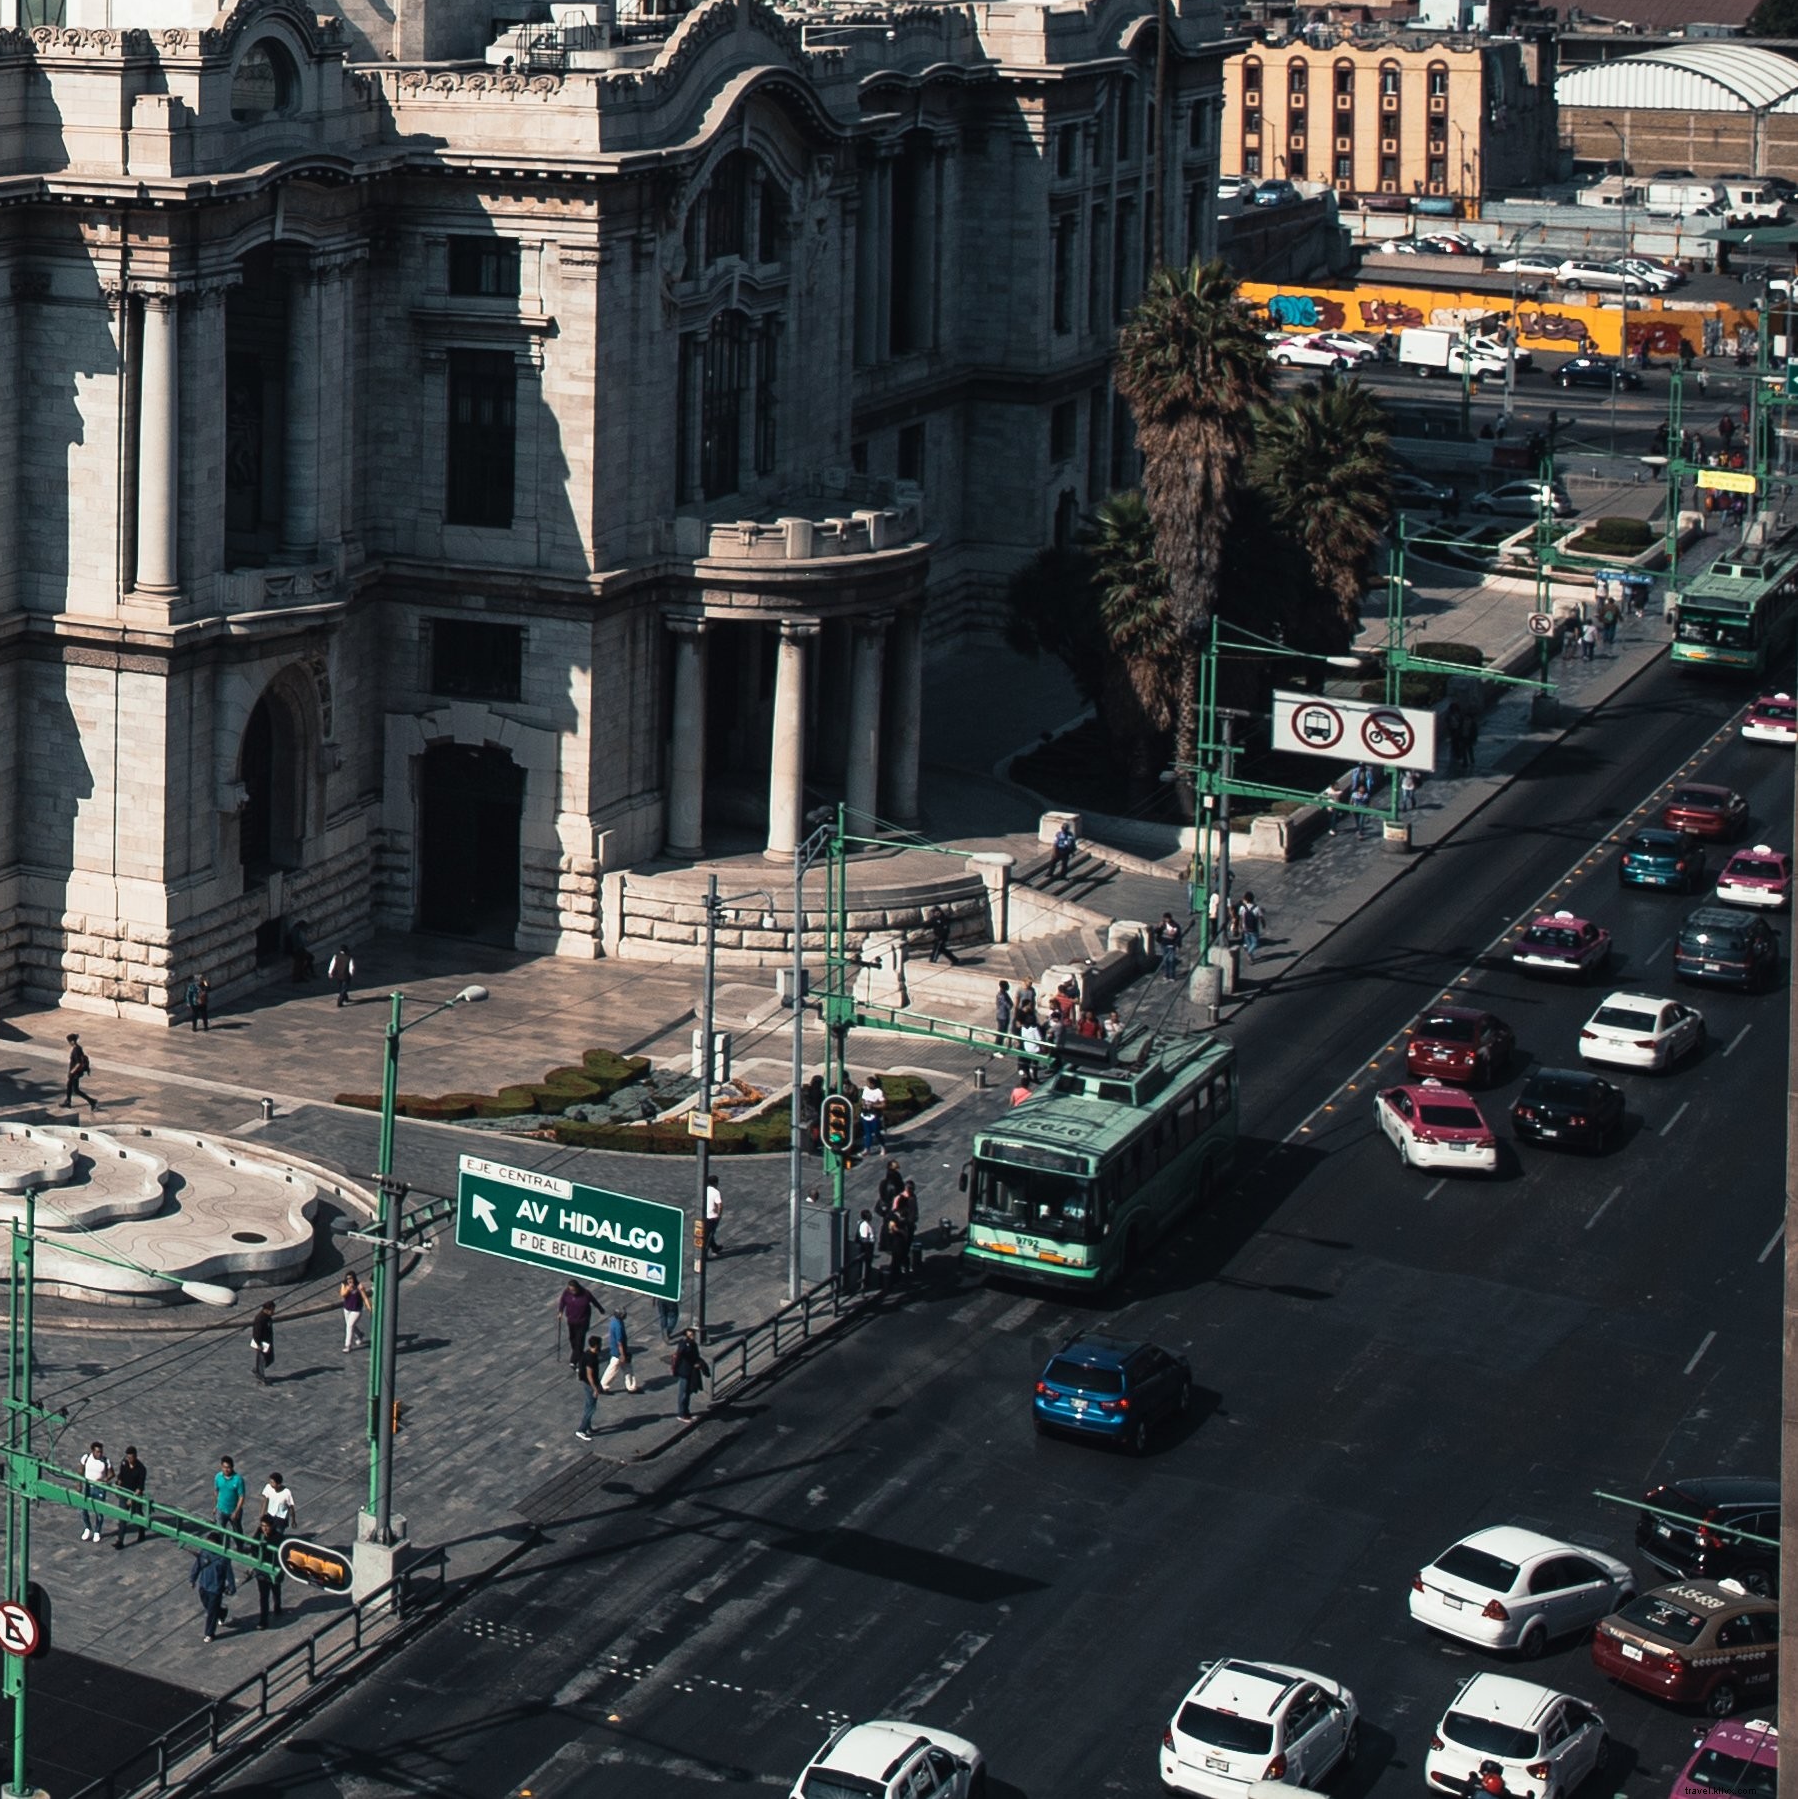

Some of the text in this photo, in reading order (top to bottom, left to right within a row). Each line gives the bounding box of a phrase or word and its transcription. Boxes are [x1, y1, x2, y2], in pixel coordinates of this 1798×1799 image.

[1026, 1122, 1082, 1137] 9792
[466, 1158, 562, 1192] EJE CENTRAL
[515, 1199, 664, 1254] AV HIDALGO
[1015, 1236, 1040, 1247] 9792
[519, 1232, 639, 1275] P DE BELLAS ARTES
